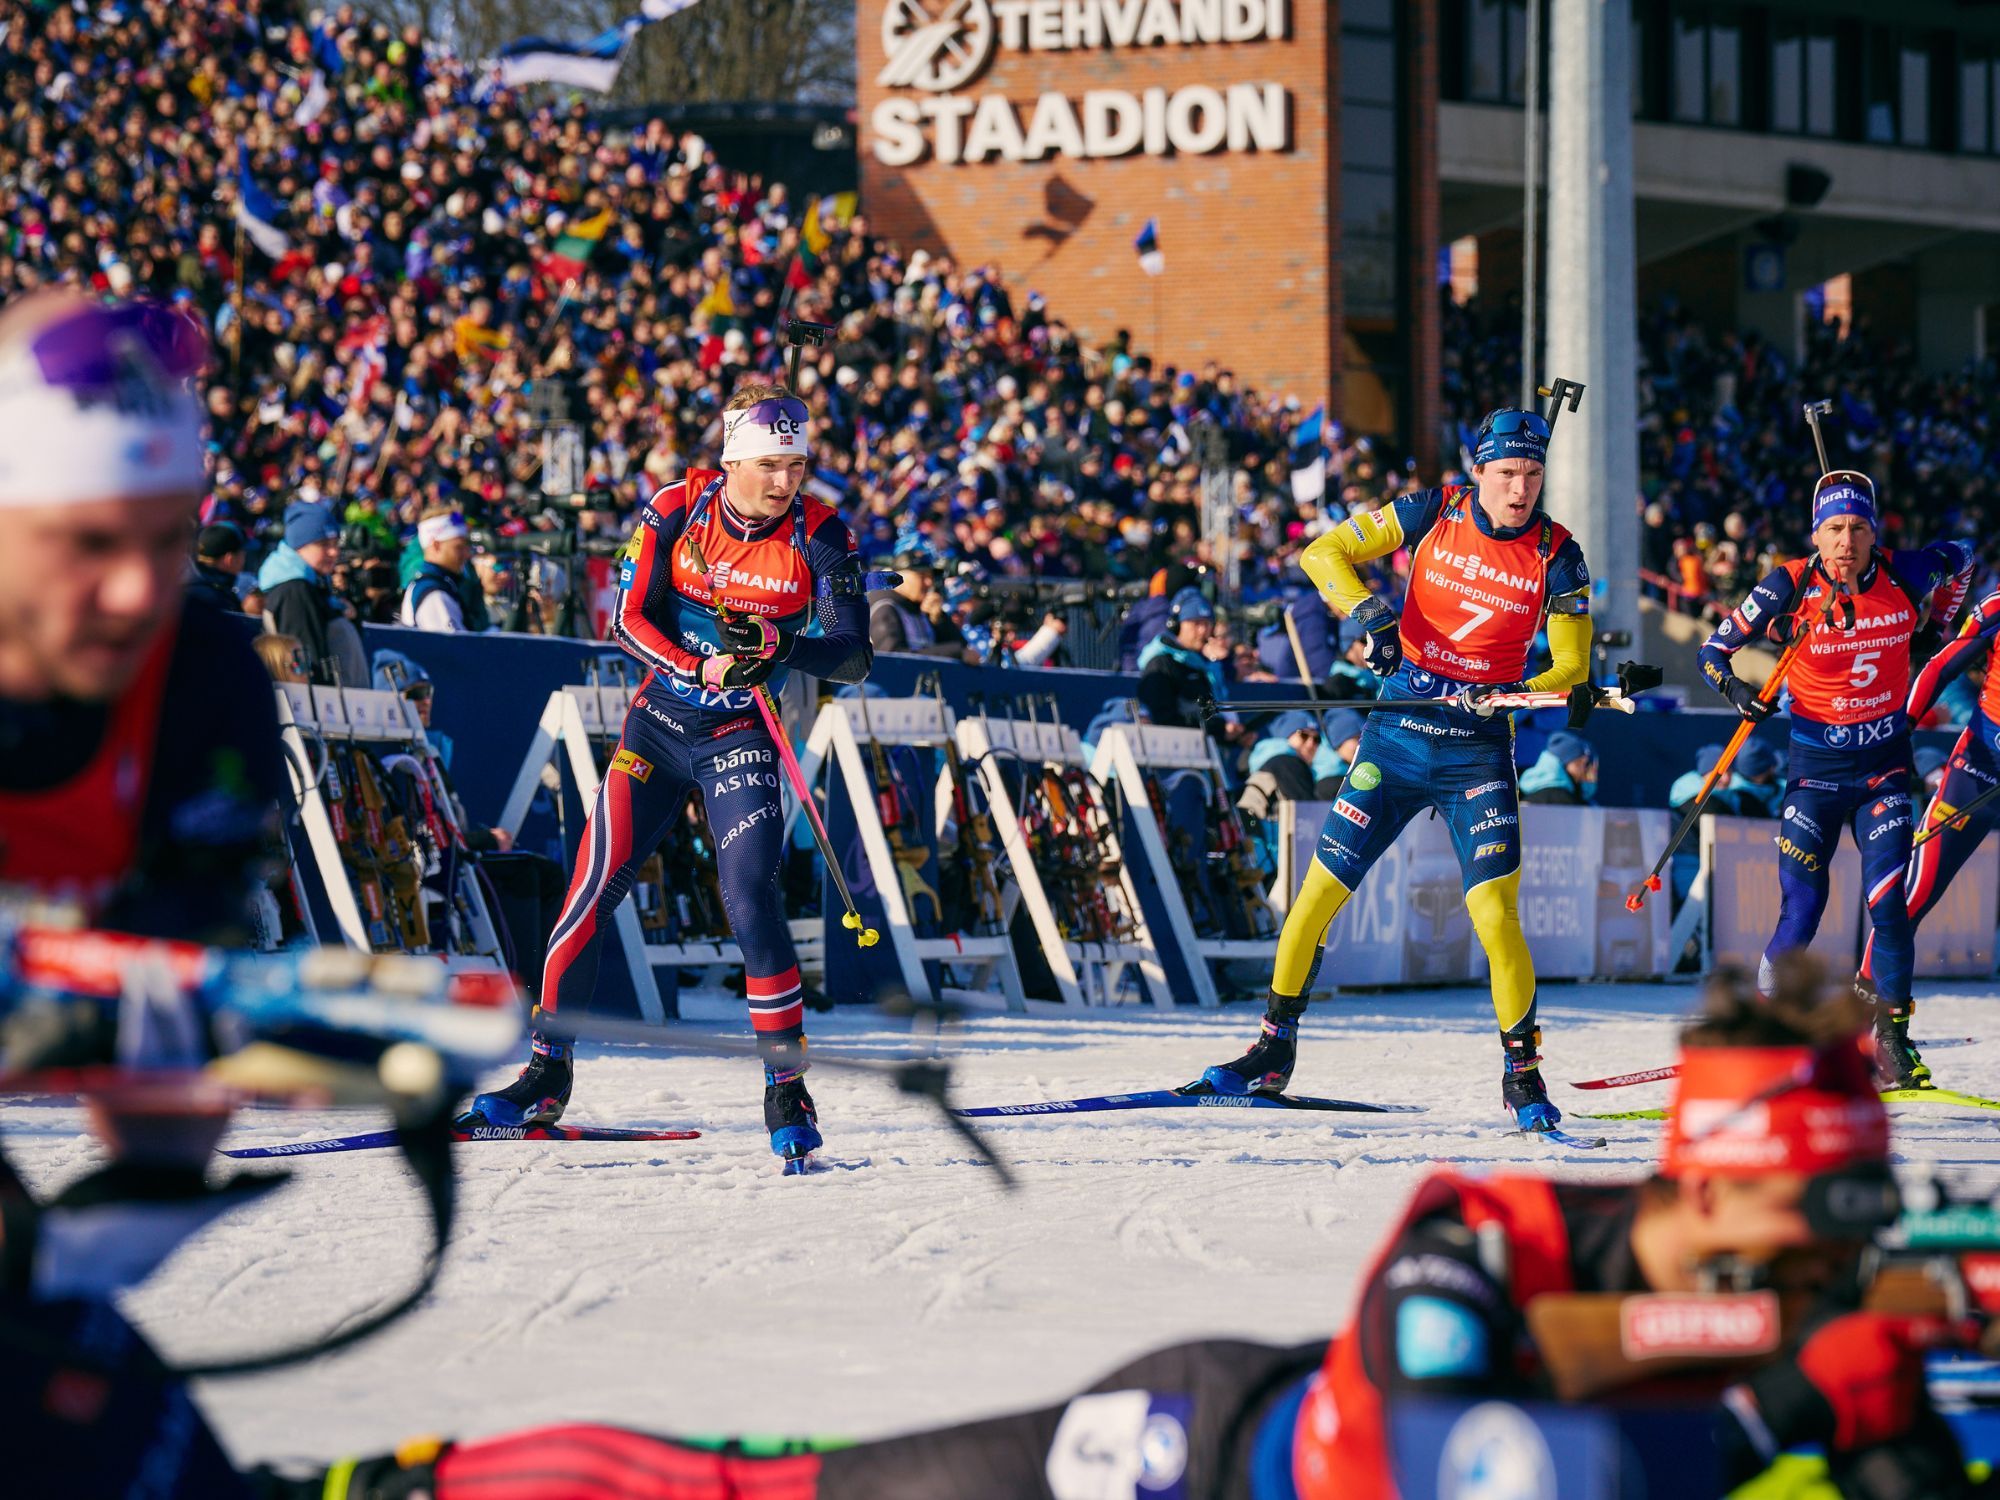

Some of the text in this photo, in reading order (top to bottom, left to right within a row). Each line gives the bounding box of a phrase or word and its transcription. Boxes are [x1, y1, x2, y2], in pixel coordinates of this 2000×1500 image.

[993, 0, 1286, 51] TEHVANDI
[872, 83, 1289, 166] STAADION
[1433, 546, 1539, 595] VIESSMANN
[683, 582, 712, 600] Hea
[1425, 568, 1530, 615] Wärmepumpen
[723, 596, 779, 616] pumps
[1447, 600, 1495, 643] 7
[1810, 631, 1911, 655] Wärmepumpen
[1440, 649, 1491, 672] Otepää
[1849, 651, 1881, 689] 5
[1850, 689, 1892, 710] Otepää
[645, 702, 685, 734] LAPUA
[1400, 717, 1449, 737] Monitor
[1449, 728, 1476, 738] ERP
[1858, 715, 1895, 746] iX3
[615, 755, 631, 766] Uno
[1963, 763, 1998, 786] LAPUA
[1333, 800, 1370, 828] NIBE
[721, 807, 768, 850] CRAFT
[1475, 843, 1507, 859] ATG
[1779, 835, 1821, 872] somfy
[998, 1101, 1078, 1114] SALOMON
[1197, 1096, 1253, 1108] SALOMON
[471, 1127, 527, 1141] SALOMON
